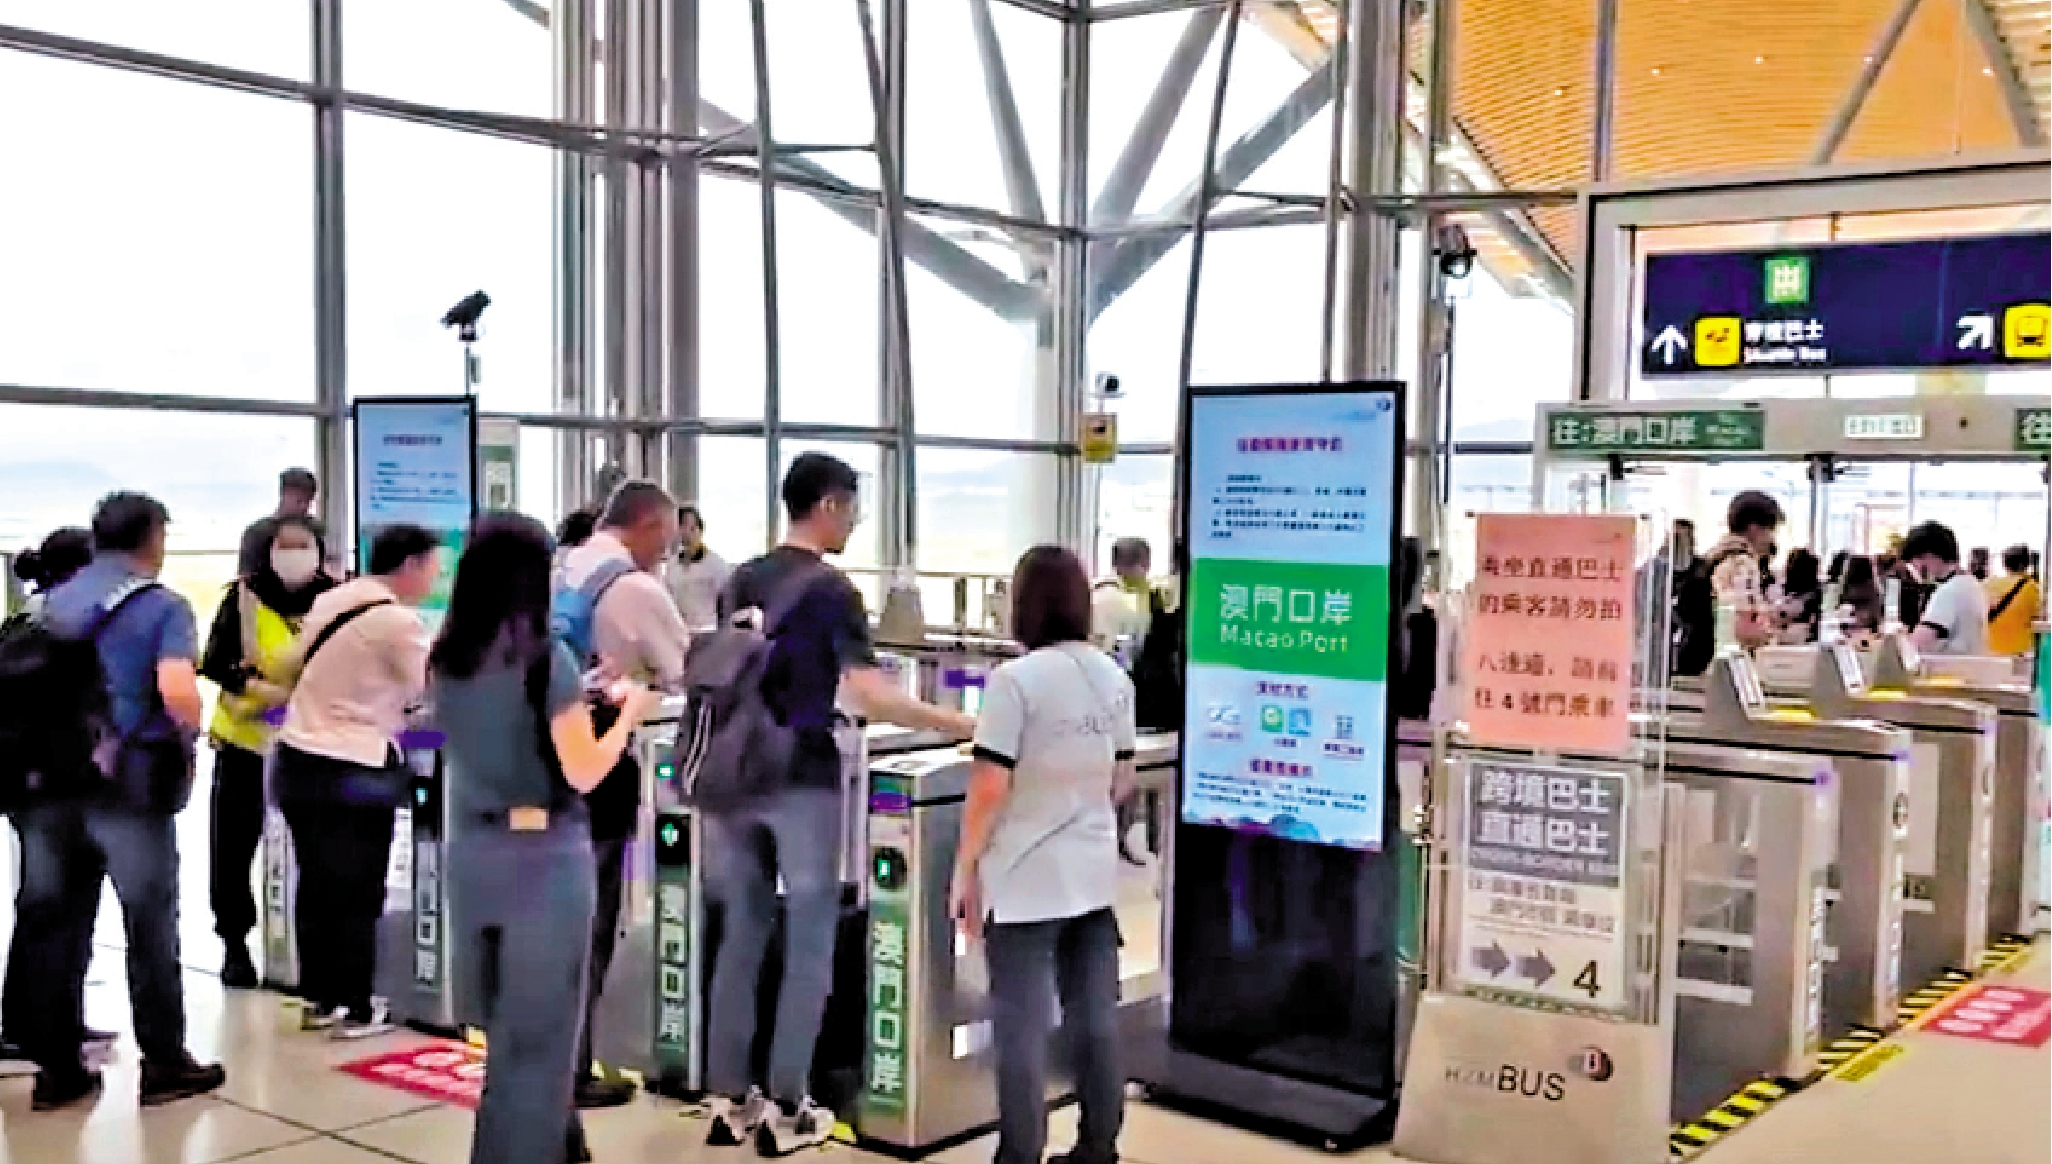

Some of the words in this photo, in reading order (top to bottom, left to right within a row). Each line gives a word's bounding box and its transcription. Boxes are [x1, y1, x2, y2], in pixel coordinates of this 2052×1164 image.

[1219, 582, 1353, 626] 澳門口岸
[1220, 622, 1296, 649] Macao
[1299, 628, 1349, 654] Port
[1479, 770, 1611, 814] 跨境巴士
[1475, 810, 1611, 856] 直通巴士
[1572, 959, 1602, 999] 4
[872, 921, 903, 1094] 澳門口岸
